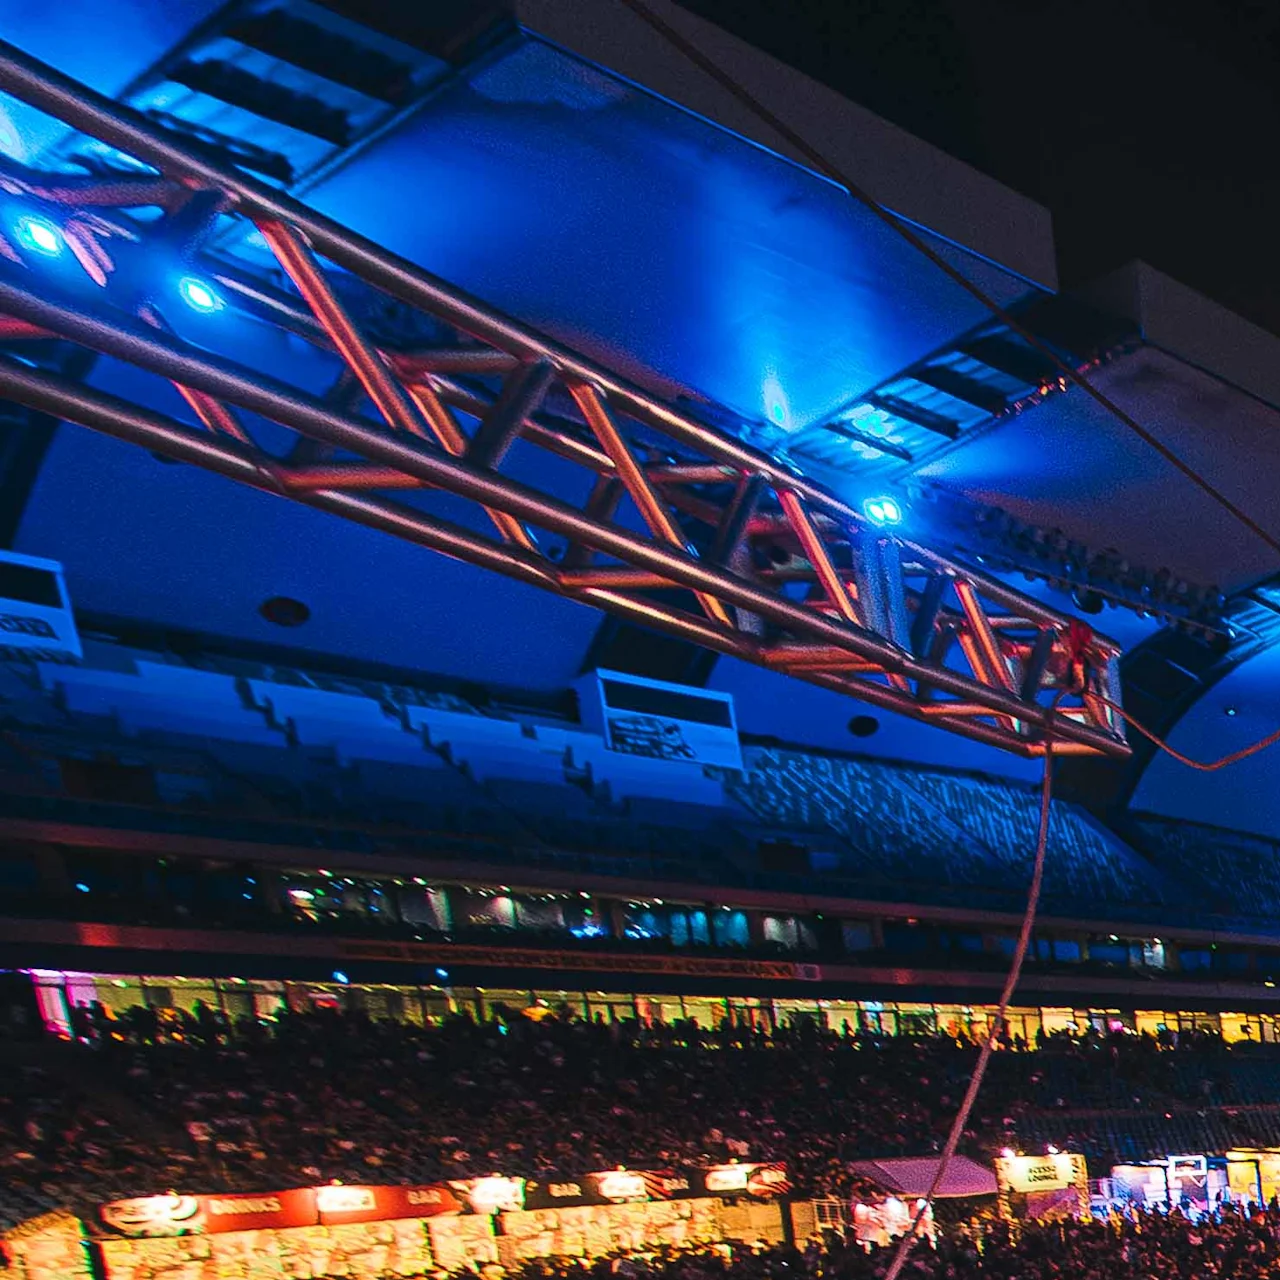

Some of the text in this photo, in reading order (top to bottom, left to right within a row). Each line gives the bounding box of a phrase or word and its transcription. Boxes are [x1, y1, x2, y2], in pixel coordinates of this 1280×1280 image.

[407, 1189, 442, 1205] BAR
[549, 1183, 581, 1197] BAR
[209, 1197, 281, 1215] DRINKS
